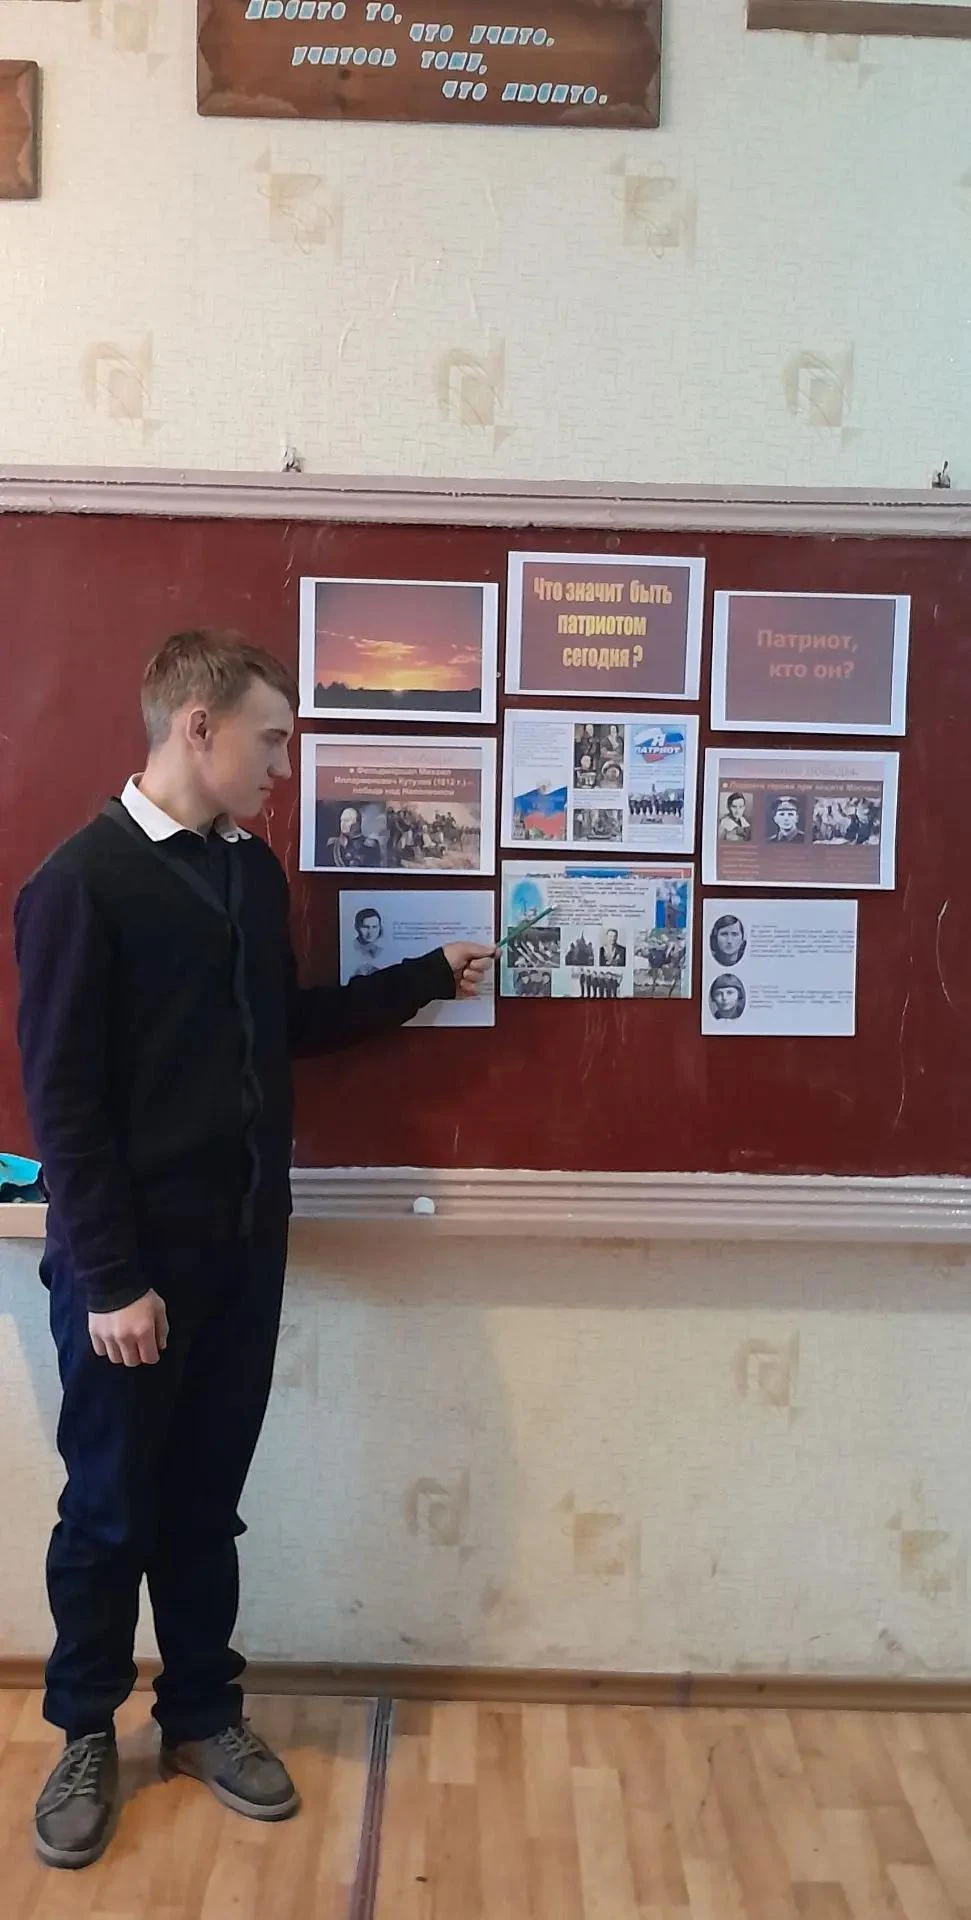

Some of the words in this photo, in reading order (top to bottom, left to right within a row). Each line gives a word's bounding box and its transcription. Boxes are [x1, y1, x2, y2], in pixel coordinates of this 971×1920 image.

[366, 2, 402, 24] ТО,
[409, 23, 454, 42] ЧТО
[442, 80, 488, 101] ЧТО
[533, 577, 562, 602] Что
[565, 580, 623, 604] значит
[629, 579, 672, 605] быть
[557, 613, 647, 637] патриотом
[757, 629, 858, 654] Патриот,
[562, 645, 630, 670] сегодня
[769, 662, 808, 679] кто
[814, 662, 855, 679] он?
[633, 746, 683, 755] ПАТРИОТ
